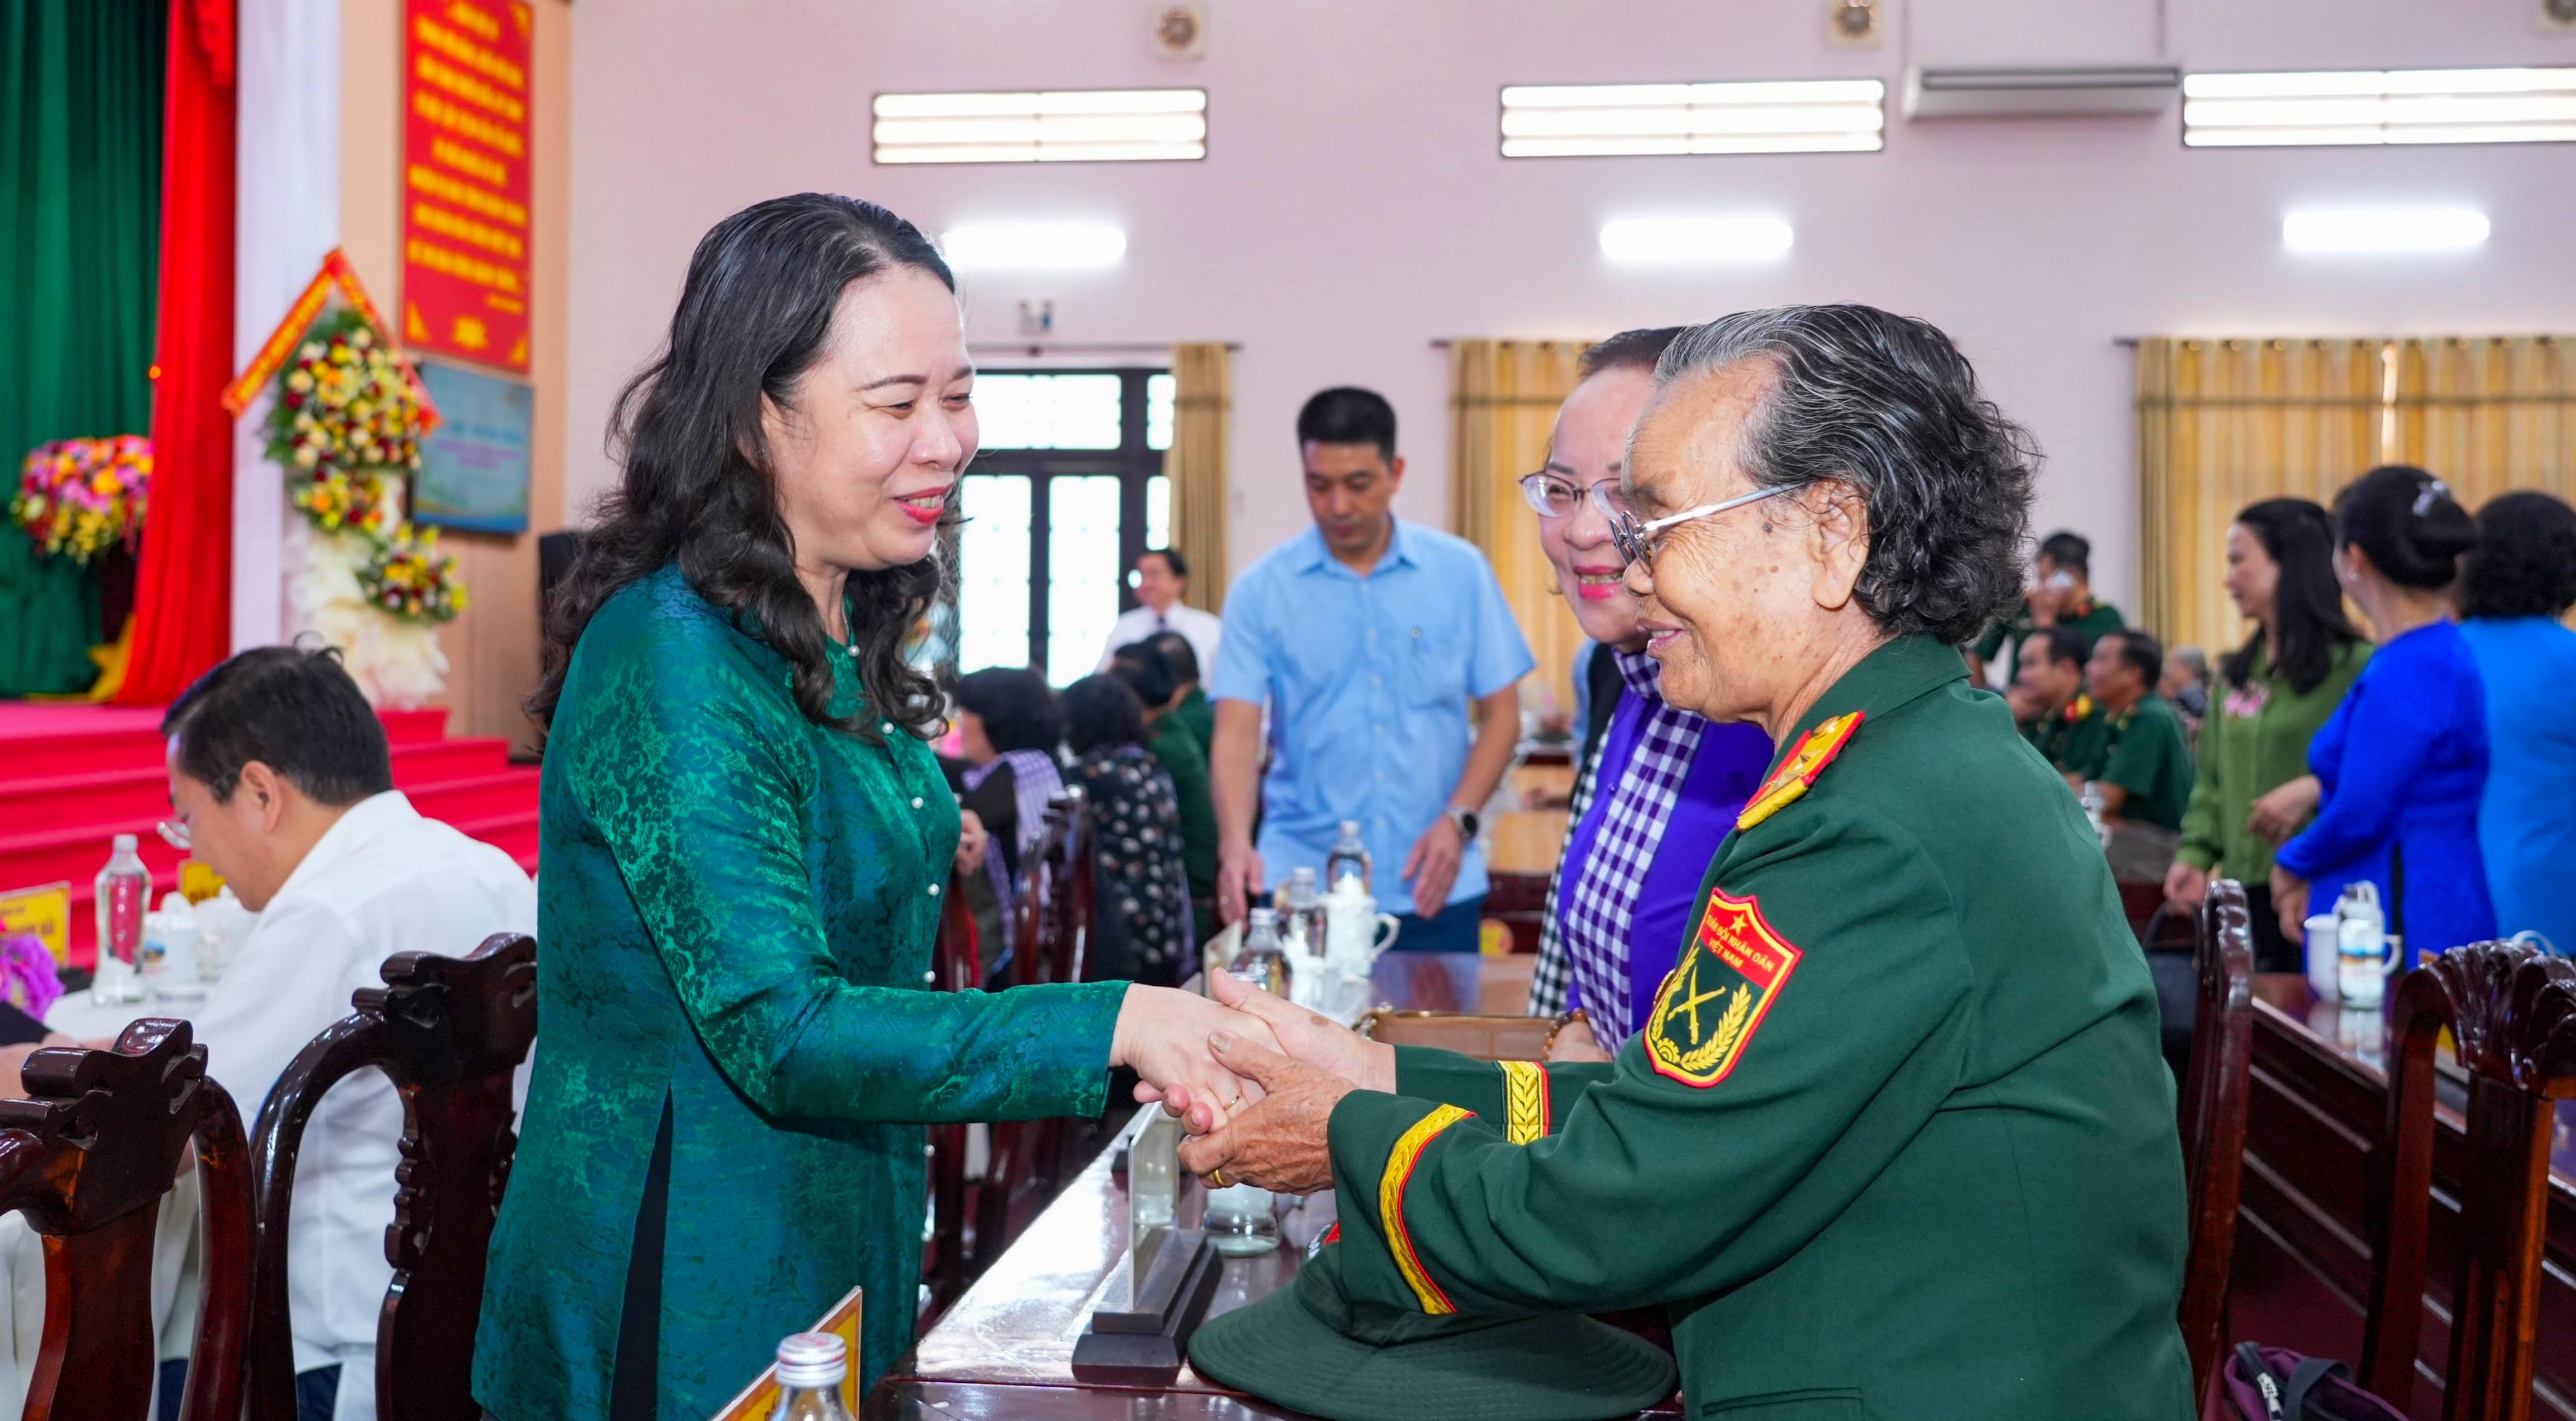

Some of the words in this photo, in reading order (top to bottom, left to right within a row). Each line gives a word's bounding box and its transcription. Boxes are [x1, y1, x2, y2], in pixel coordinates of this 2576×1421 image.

[1722, 949, 1743, 968] NAM
[1727, 935, 1753, 958] NHÂN
[1751, 952, 1775, 973] DÂN
